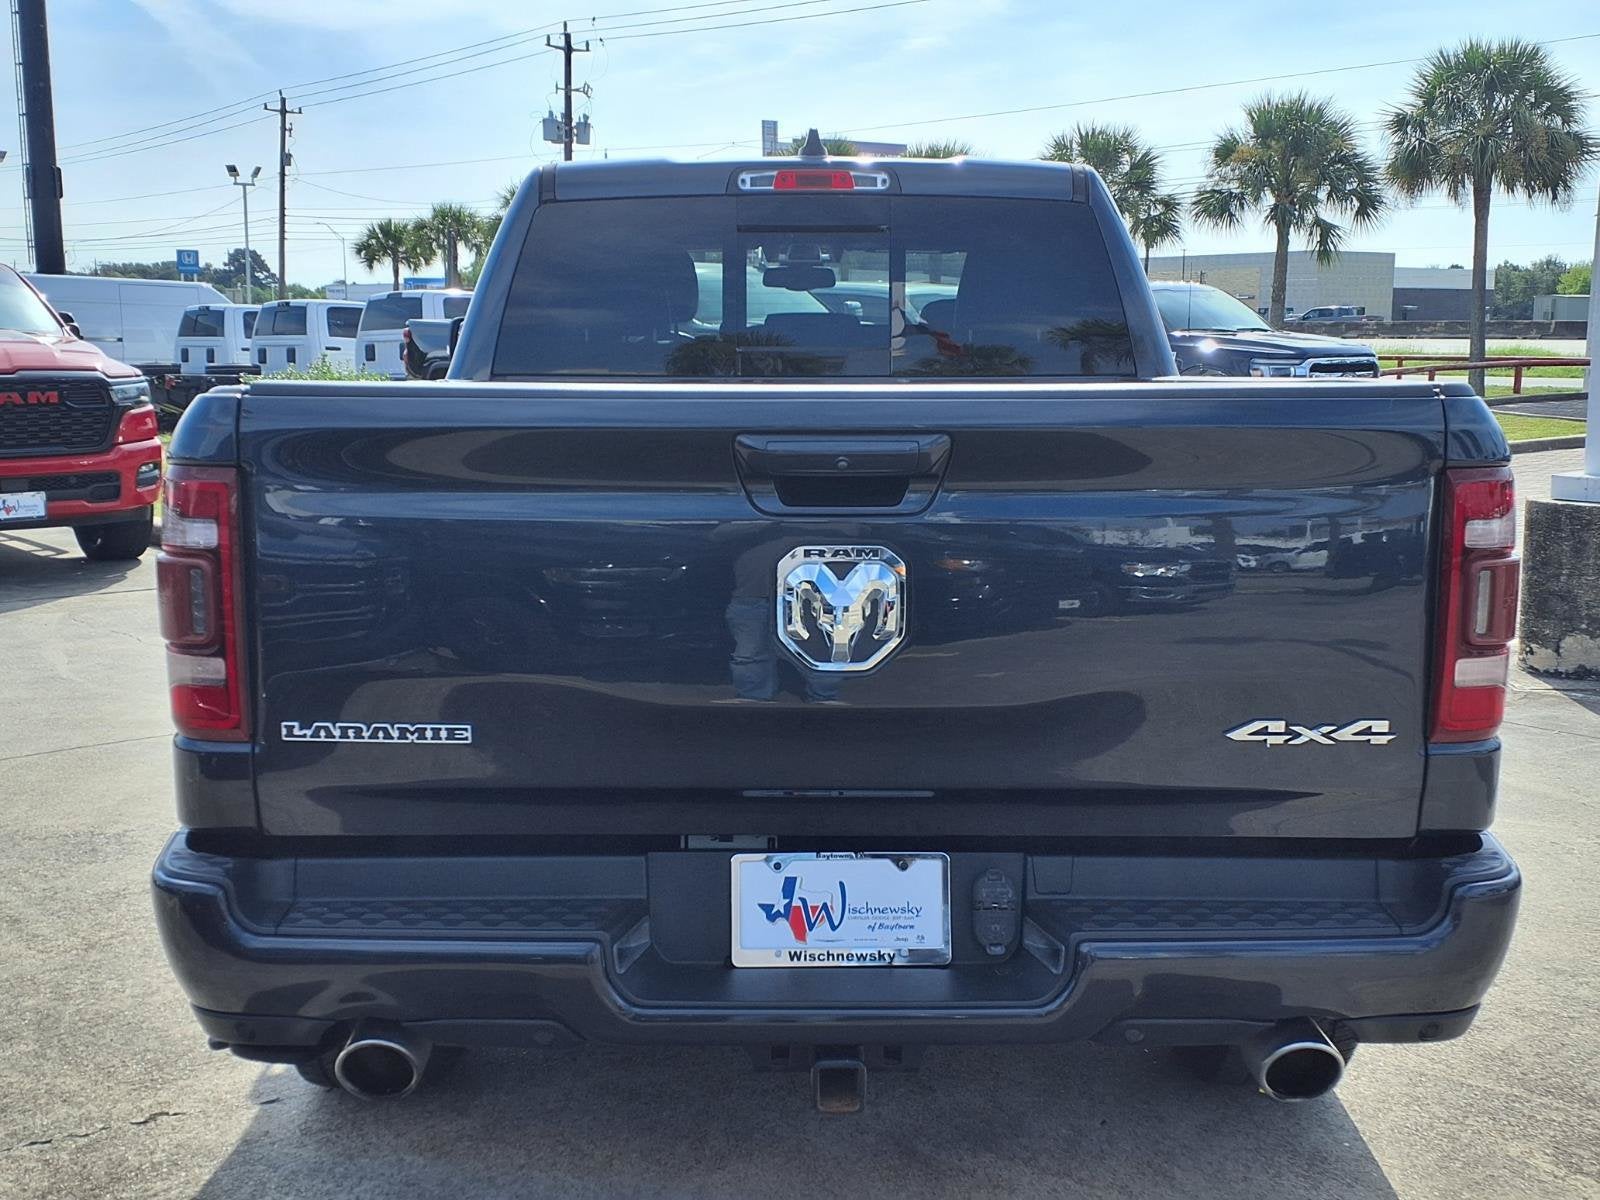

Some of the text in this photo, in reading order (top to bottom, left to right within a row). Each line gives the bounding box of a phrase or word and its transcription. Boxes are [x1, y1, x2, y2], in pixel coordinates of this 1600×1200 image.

[0, 391, 59, 404] AM
[803, 548, 879, 558] RAM
[281, 722, 472, 743] LARAMIE
[1225, 720, 1397, 745] 4x4
[867, 922, 914, 932] of Baytown
[788, 950, 896, 964] Wischnewsky
